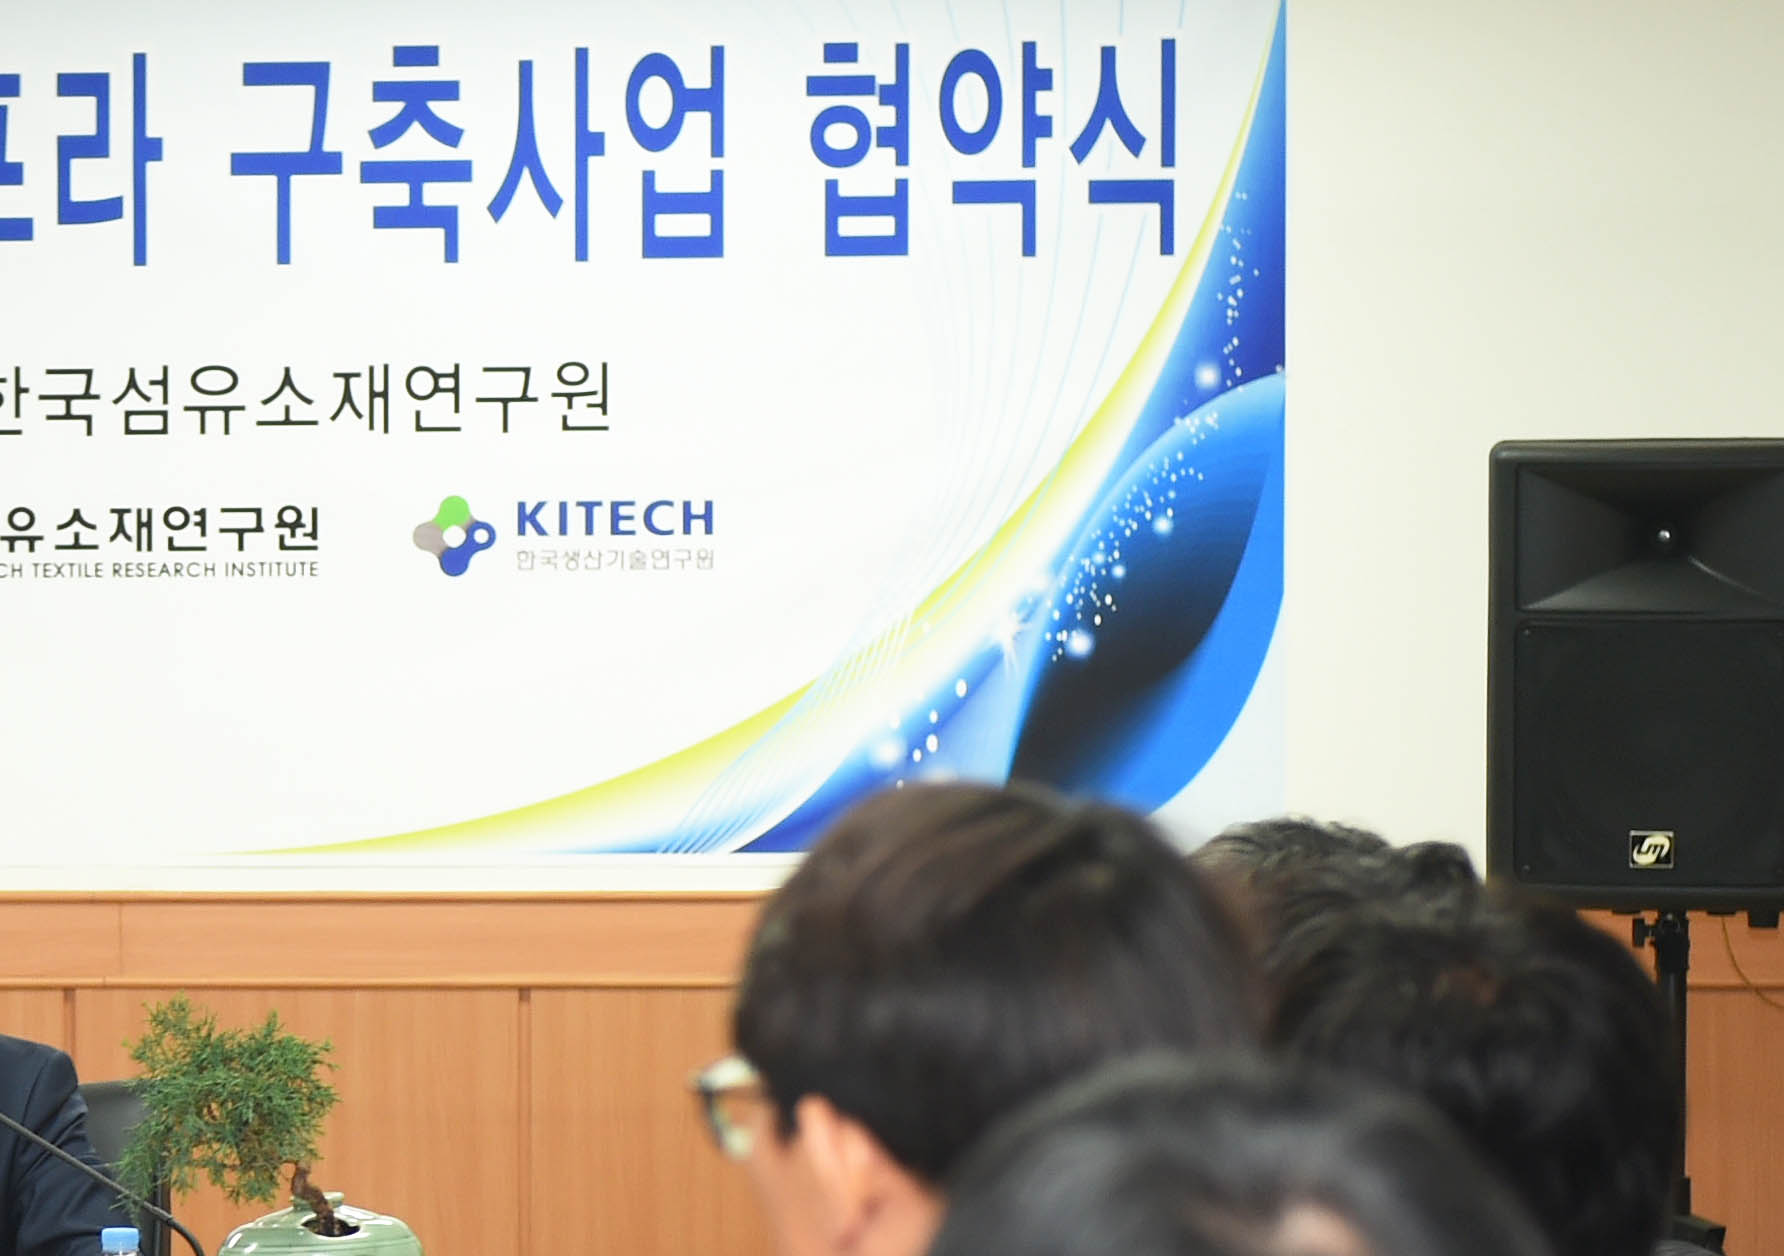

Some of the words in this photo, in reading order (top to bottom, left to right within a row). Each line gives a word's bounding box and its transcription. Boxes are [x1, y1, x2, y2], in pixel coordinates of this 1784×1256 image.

[229, 44, 726, 266] 구축사업
[805, 37, 1180, 258] 협약식
[516, 499, 714, 537] KITECH
[31, 562, 104, 579] TEXTILE
[111, 561, 216, 579] RESEARCH
[224, 561, 319, 578] INSTITUTE
[516, 547, 715, 572] 한국생산기술연구원
